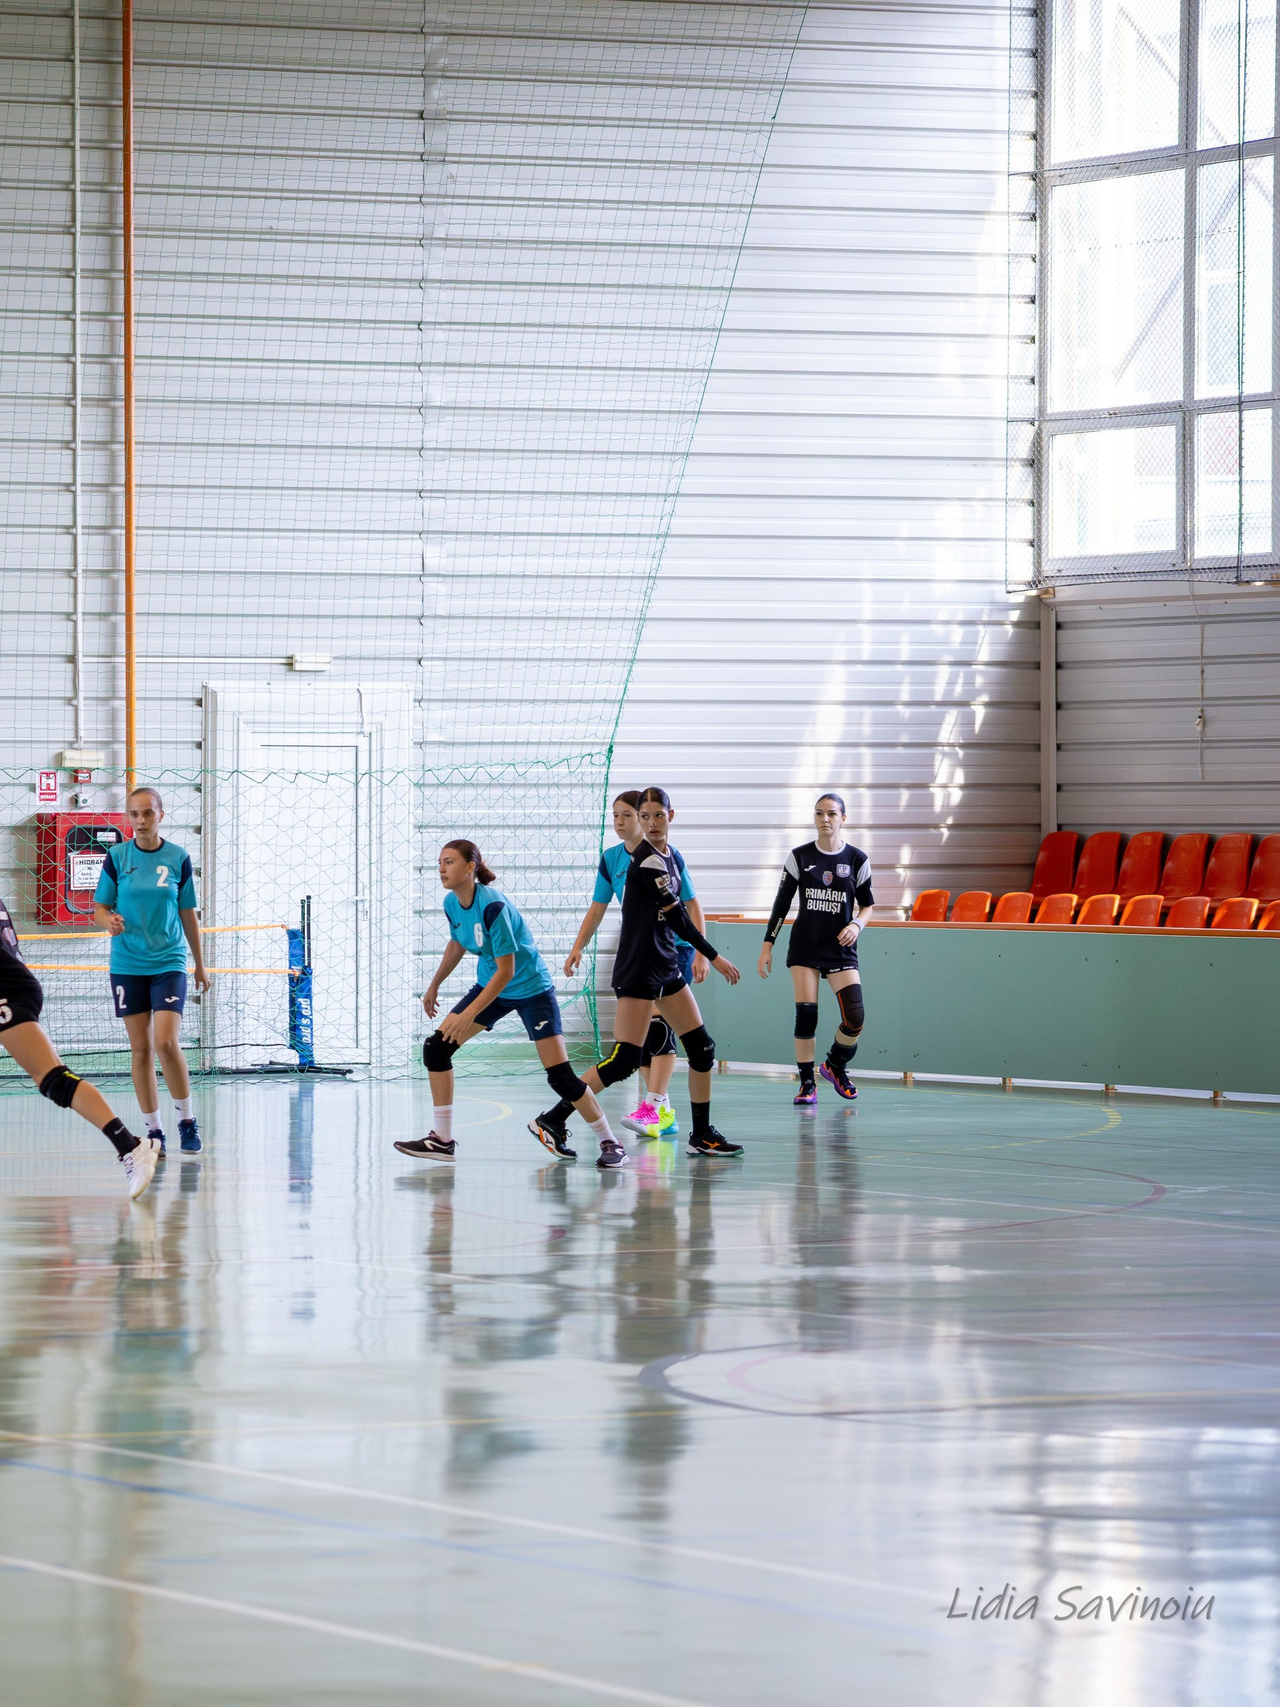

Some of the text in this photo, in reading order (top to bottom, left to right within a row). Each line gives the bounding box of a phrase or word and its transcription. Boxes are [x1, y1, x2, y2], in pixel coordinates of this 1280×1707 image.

[156, 865, 169, 887] 2
[805, 888, 847, 903] PRIMĂRIA
[116, 985, 127, 1009] 2
[298, 998, 313, 1025] pro's
